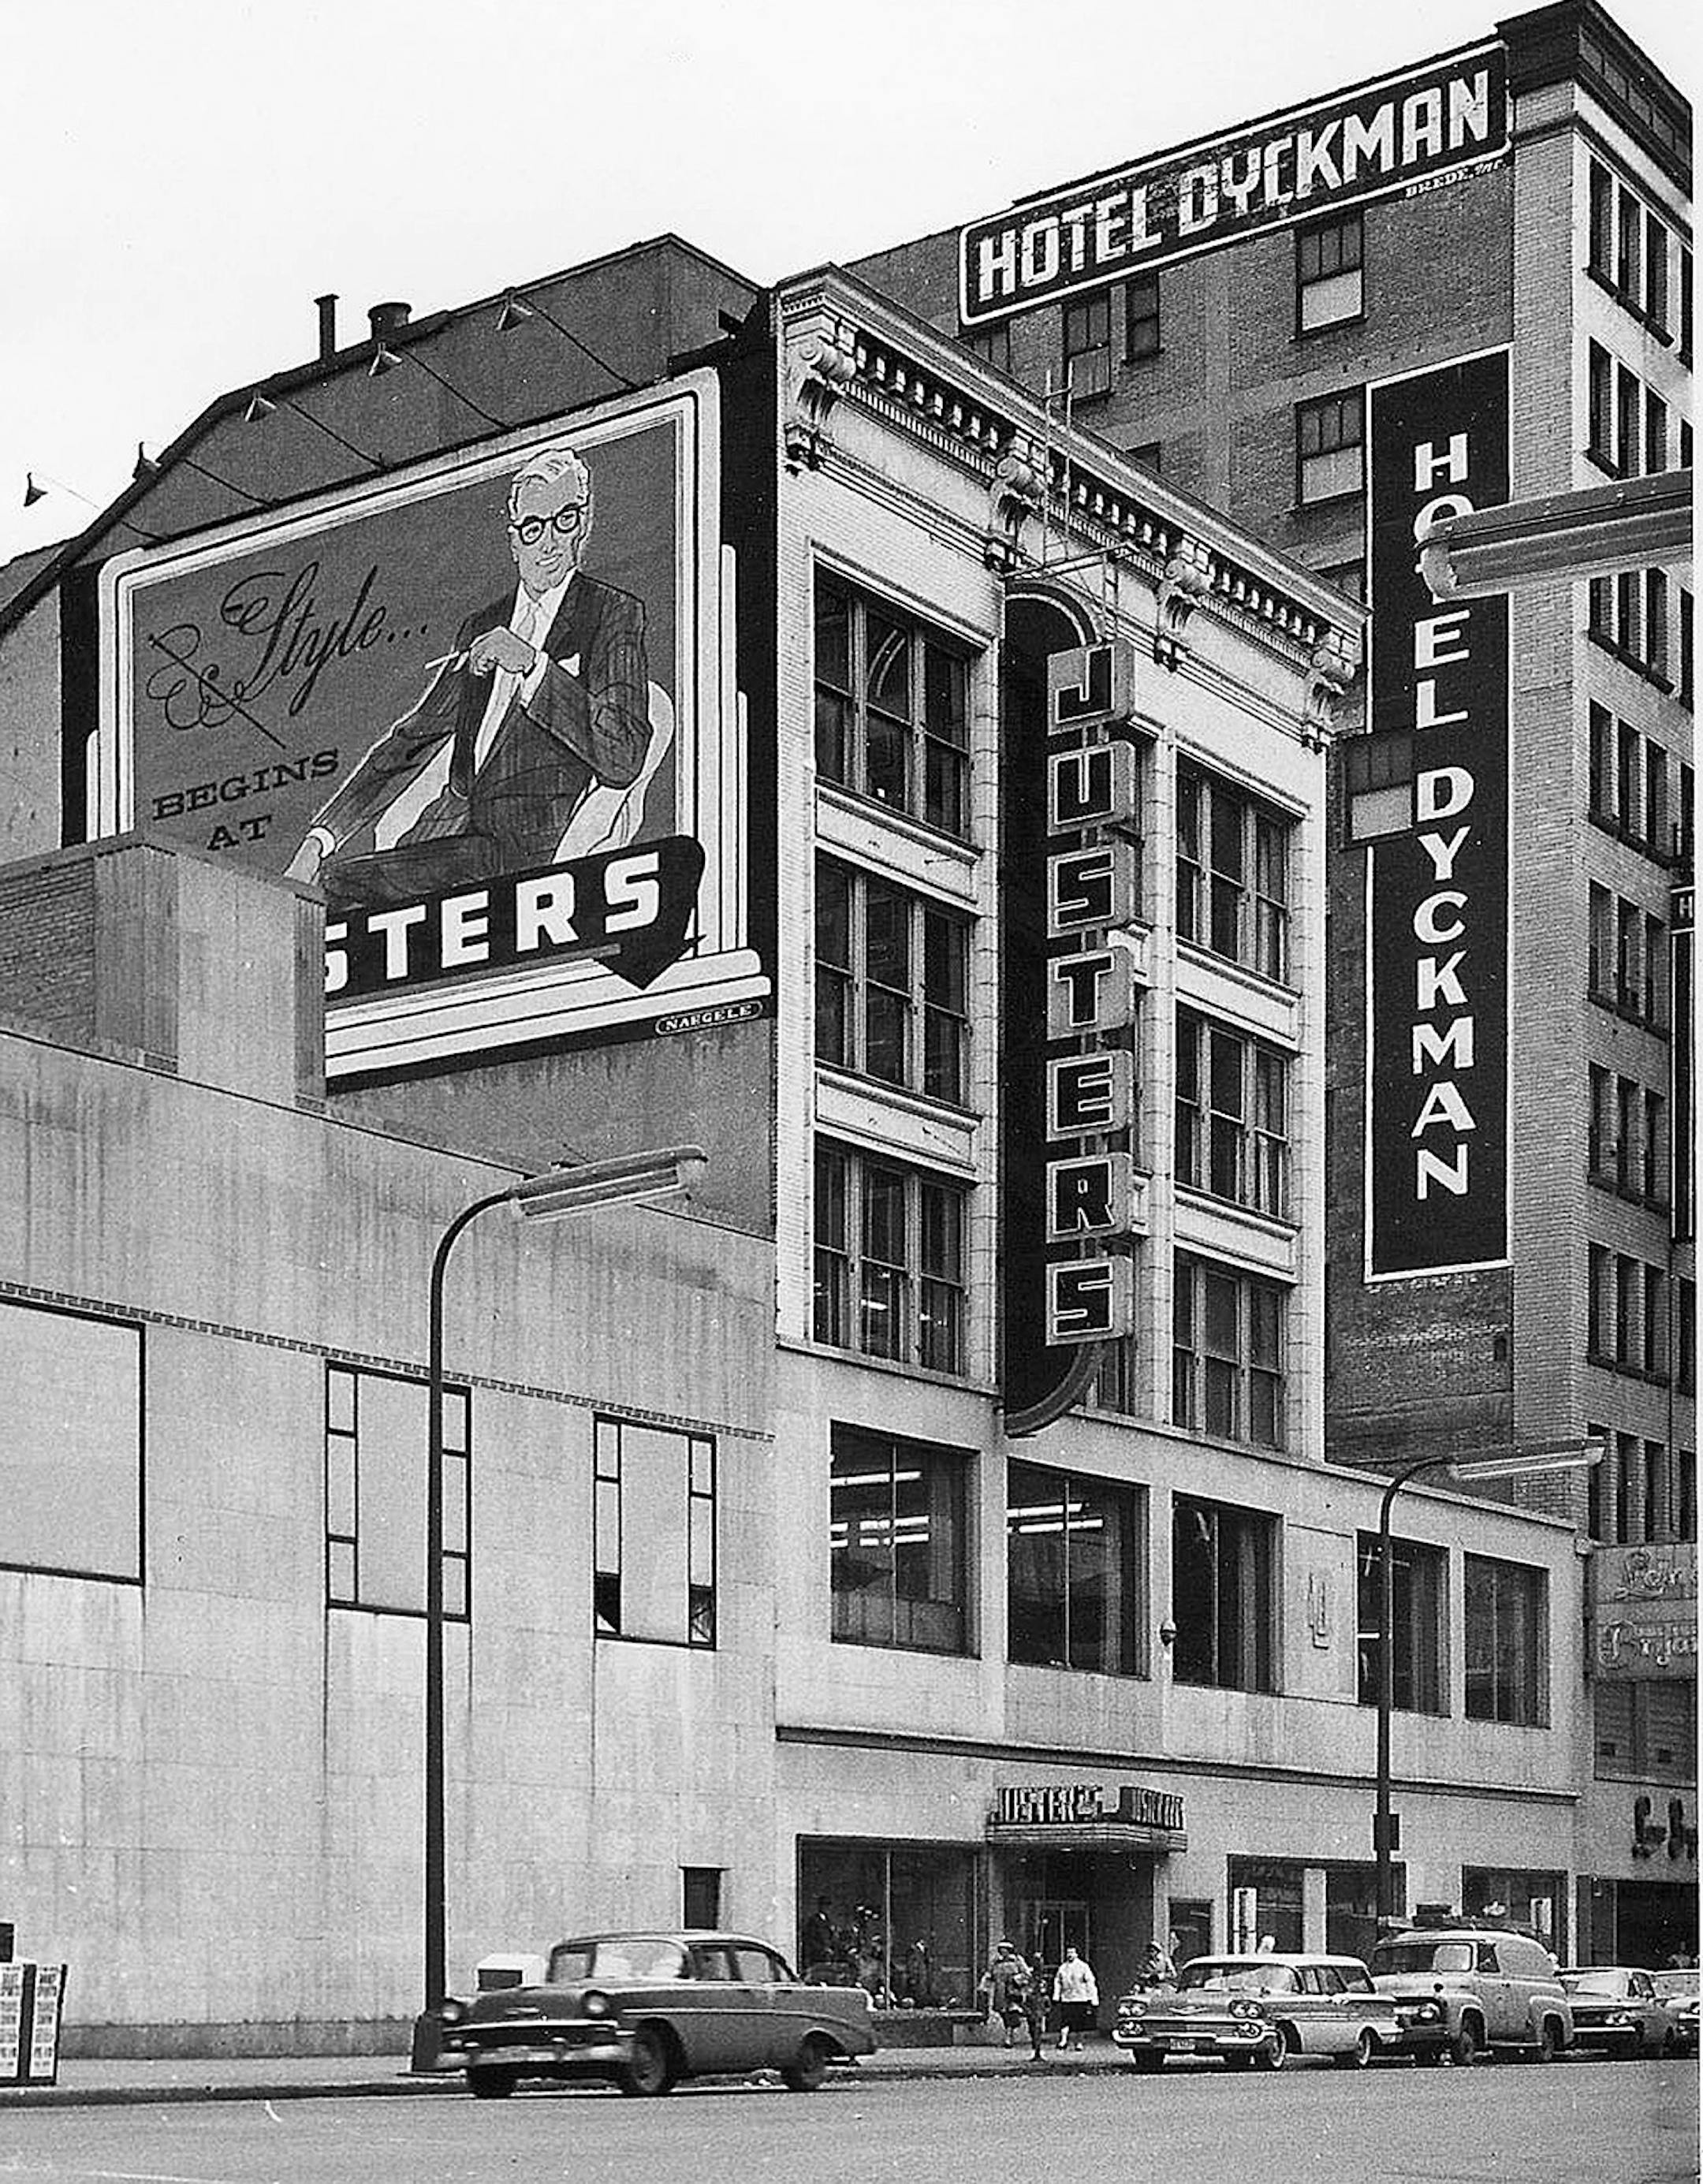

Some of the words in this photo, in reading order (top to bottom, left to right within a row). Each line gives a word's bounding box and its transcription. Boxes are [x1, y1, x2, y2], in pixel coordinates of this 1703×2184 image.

[979, 189, 1164, 304] HOTEL
[1179, 69, 1491, 237] DYCKMAN
[1414, 433, 1475, 730] HOEL
[152, 748, 339, 821] BEGINS
[207, 814, 272, 851] AT
[665, 1004, 752, 1031] NAEGELE
[1053, 644, 1116, 1338] JUSTERS
[1411, 766, 1477, 1200] DYCKMAN
